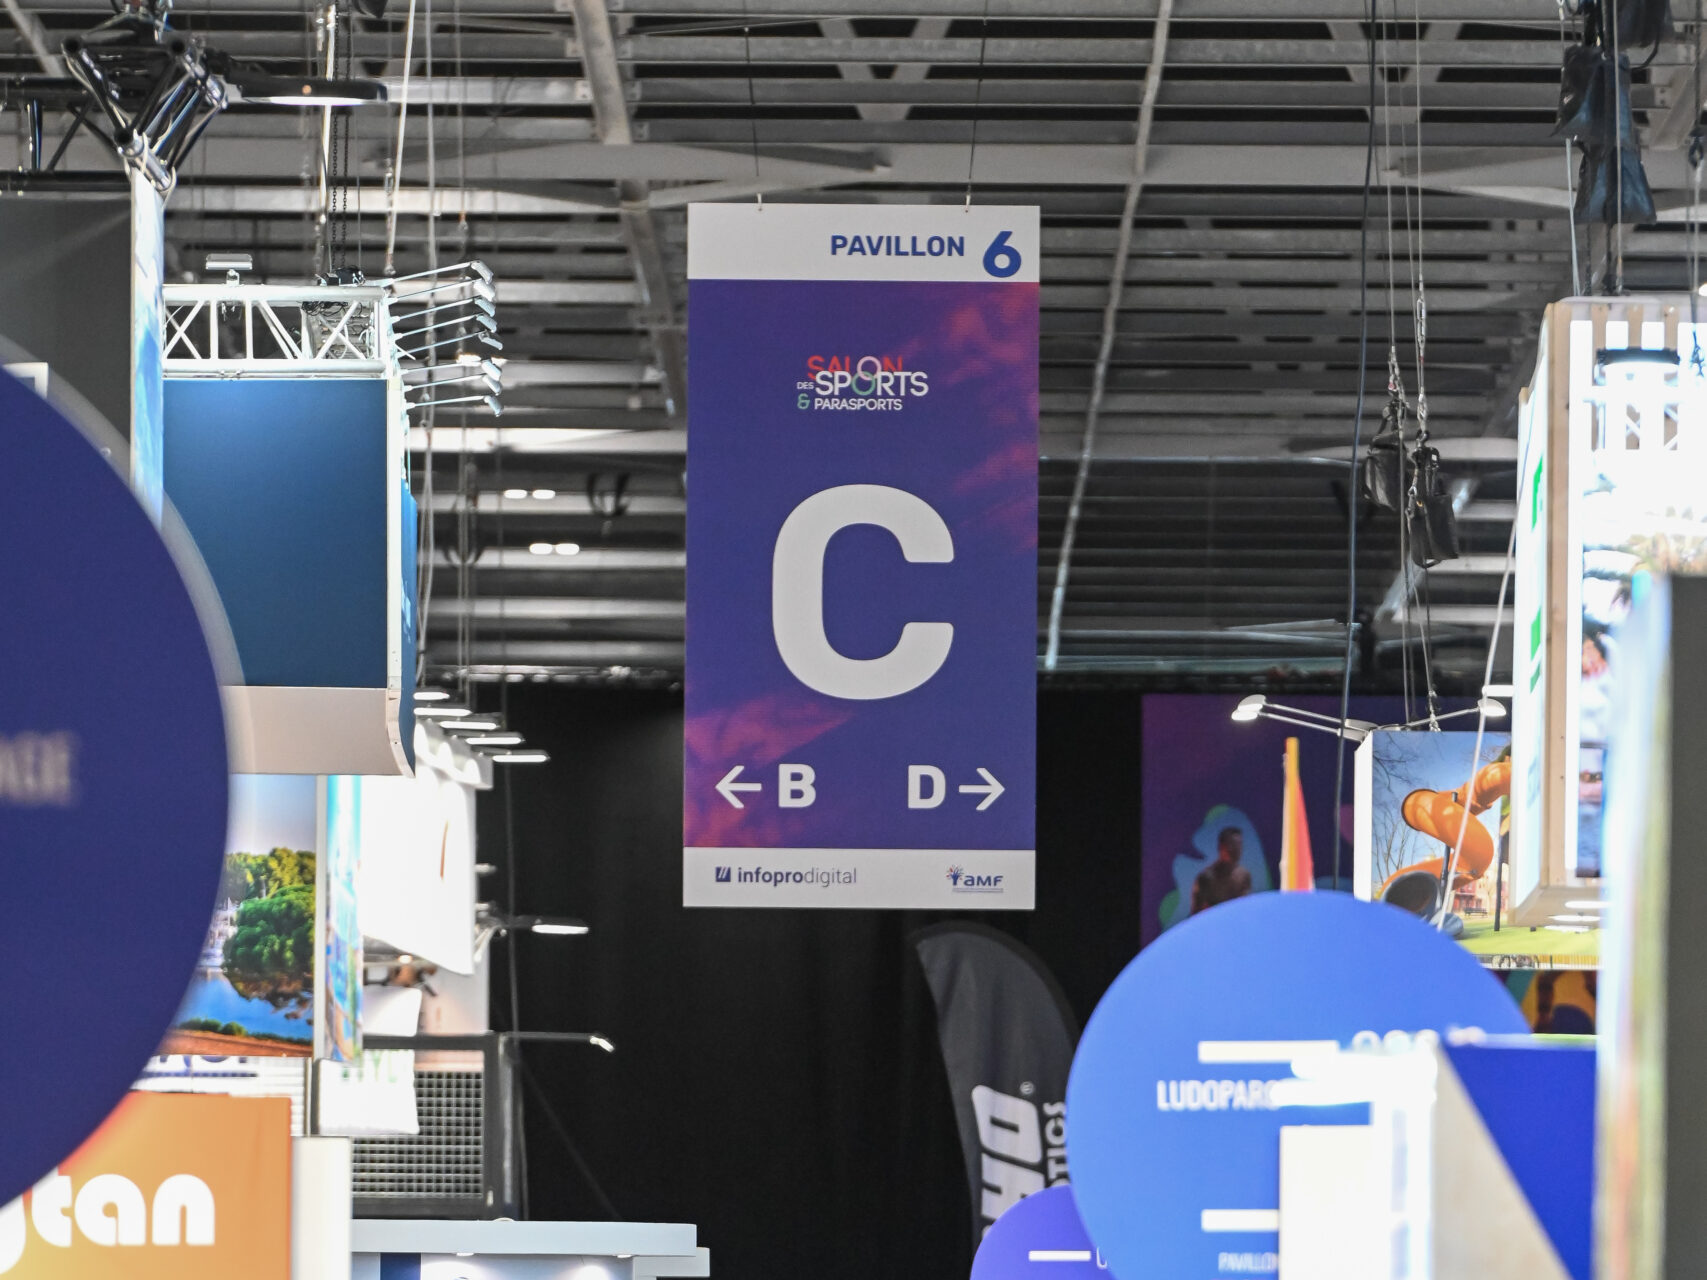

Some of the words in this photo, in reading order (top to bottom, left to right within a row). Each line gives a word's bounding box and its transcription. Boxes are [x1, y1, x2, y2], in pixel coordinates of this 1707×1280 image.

[830, 235, 965, 257] PAVILLON
[982, 230, 1022, 278] 6
[796, 381, 814, 390] DES
[815, 370, 929, 397] SPORTS
[814, 398, 903, 411] PARASPORTS
[772, 484, 954, 700] C
[778, 763, 817, 808] B
[908, 765, 946, 809] D
[737, 867, 857, 888] infoprodigital
